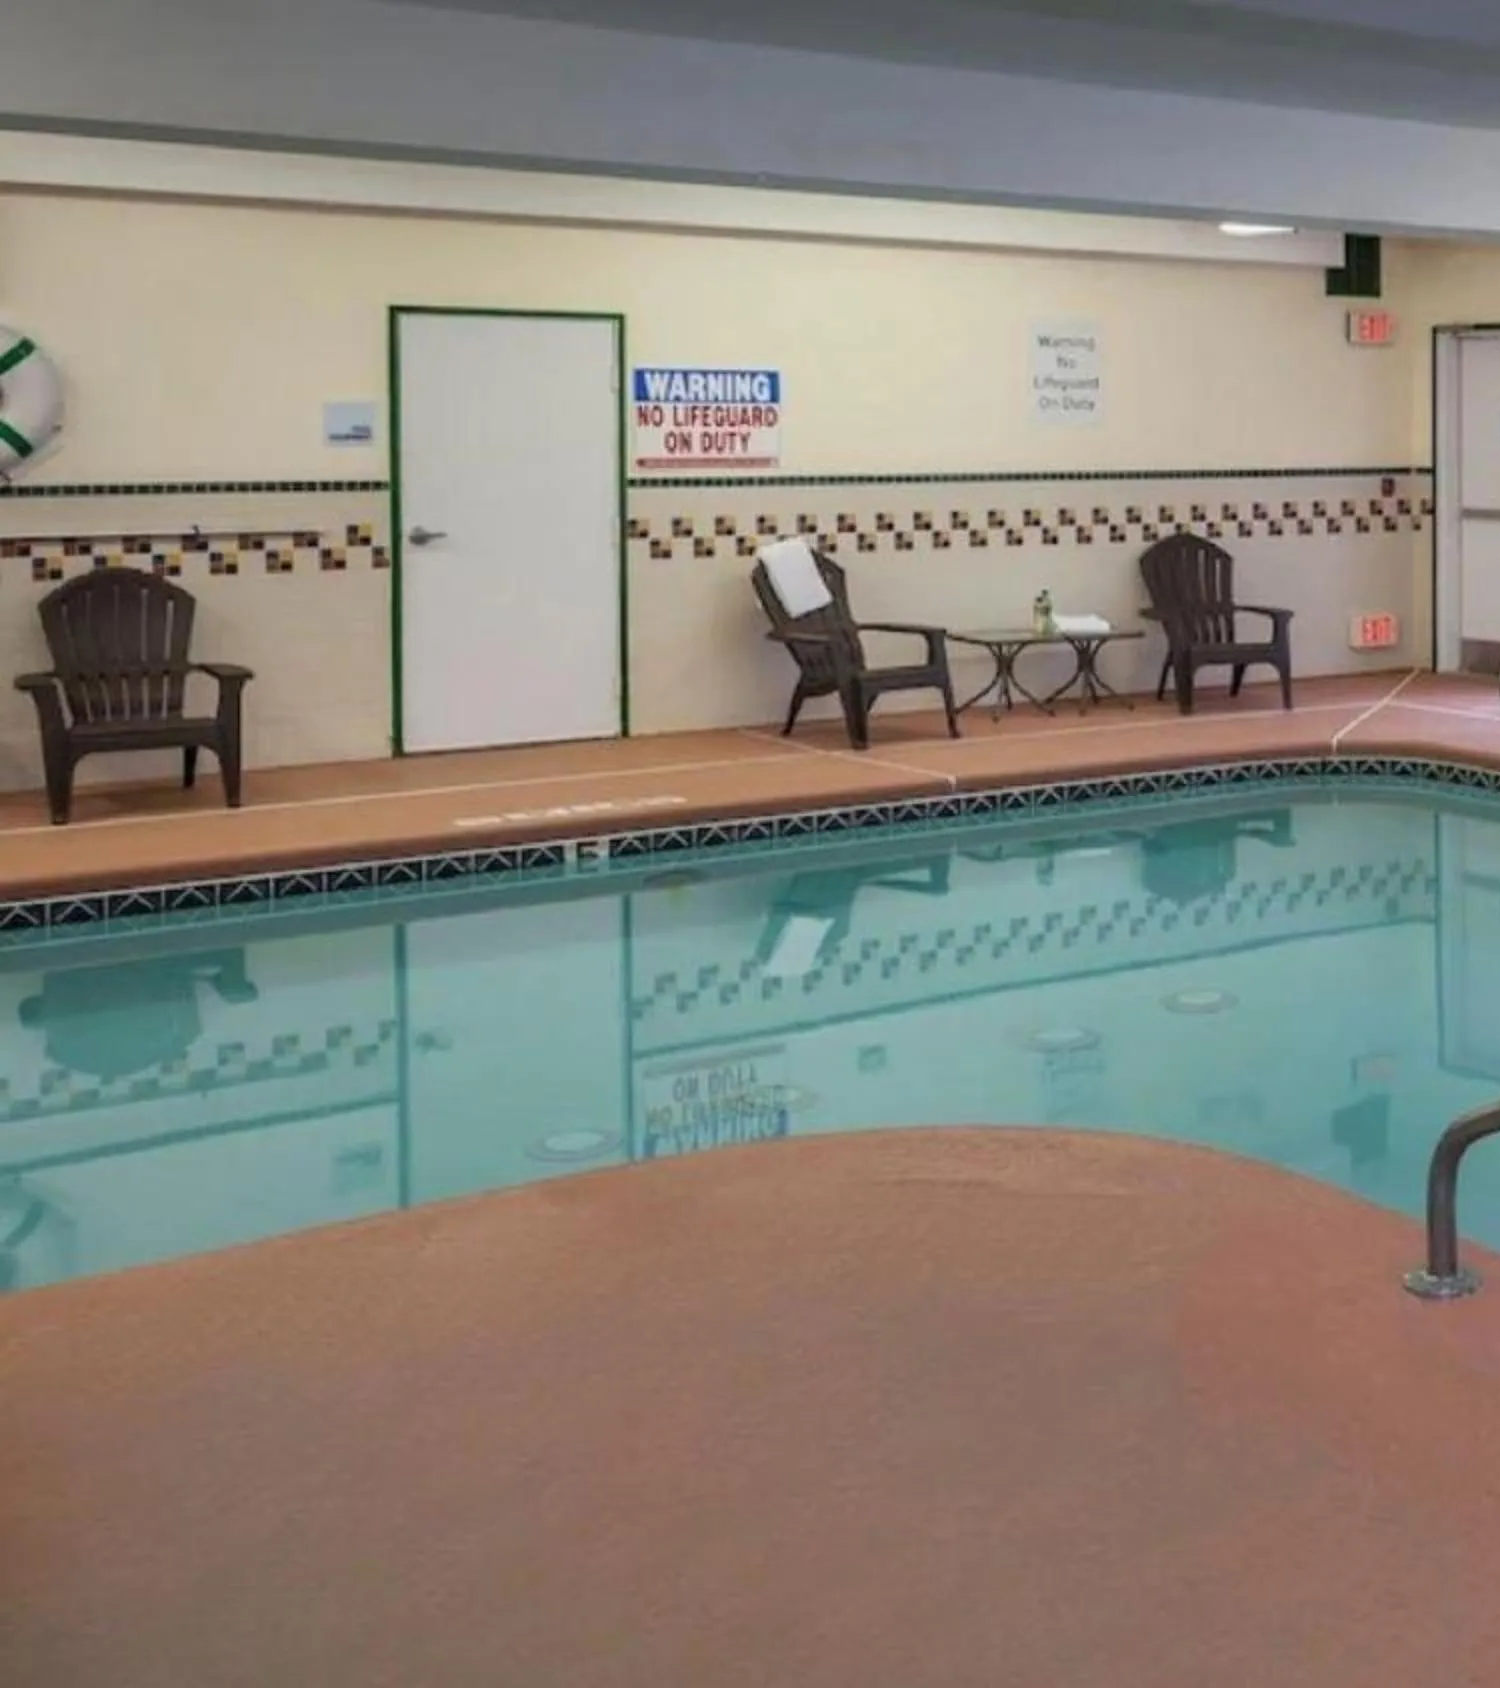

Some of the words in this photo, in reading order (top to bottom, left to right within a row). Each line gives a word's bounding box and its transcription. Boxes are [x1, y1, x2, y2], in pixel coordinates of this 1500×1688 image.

[643, 371, 772, 402] WARNING
[637, 405, 664, 428] NO
[672, 405, 779, 428] LIFEGUARD
[664, 431, 692, 454] ON
[701, 431, 752, 454] DUTY
